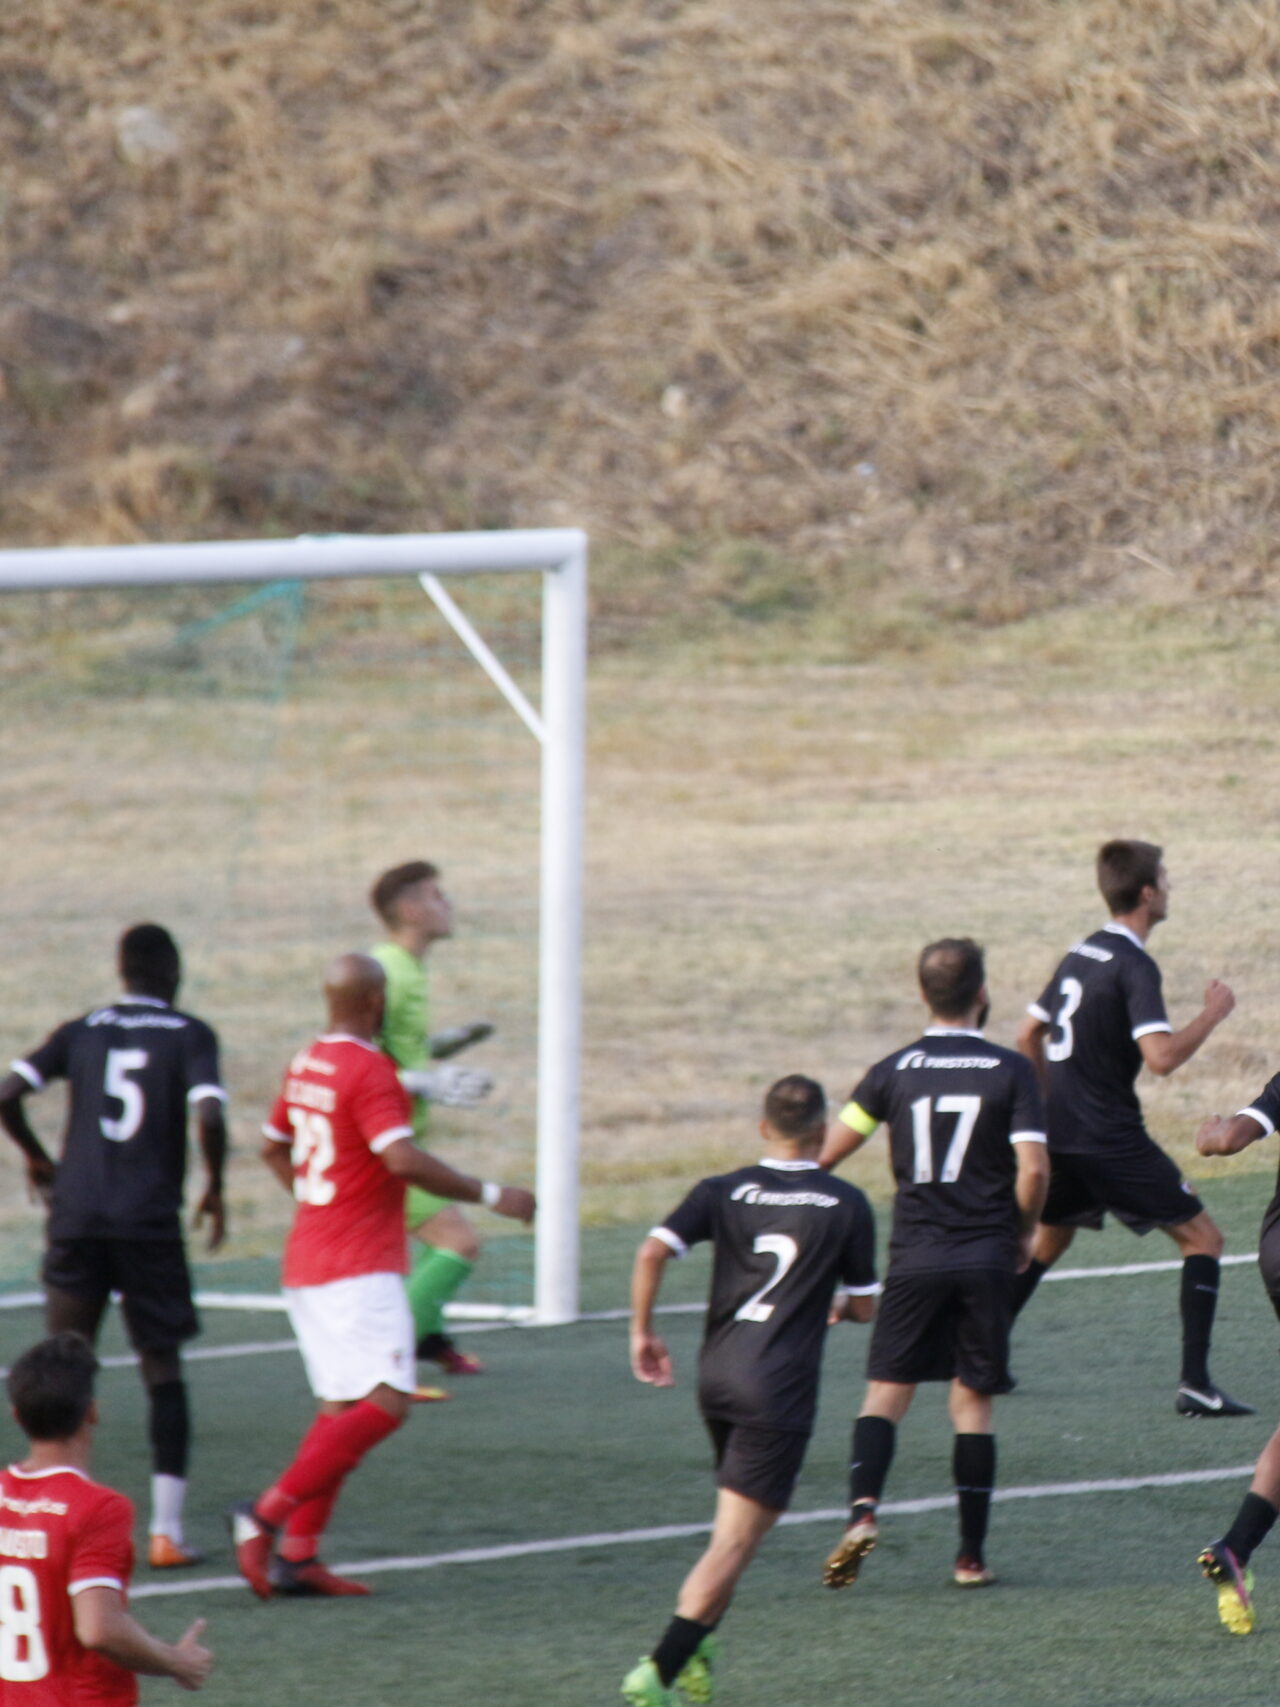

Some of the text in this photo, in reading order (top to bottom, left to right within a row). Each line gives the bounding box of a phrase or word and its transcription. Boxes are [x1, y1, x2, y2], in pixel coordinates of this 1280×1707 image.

[924, 1056, 1001, 1070] FIRSTSTOP
[1042, 976, 1083, 1062] 3
[99, 1048, 149, 1142] 5
[910, 1095, 982, 1184] 17
[733, 1233, 798, 1322] 2
[0, 1565, 49, 1682] 8
